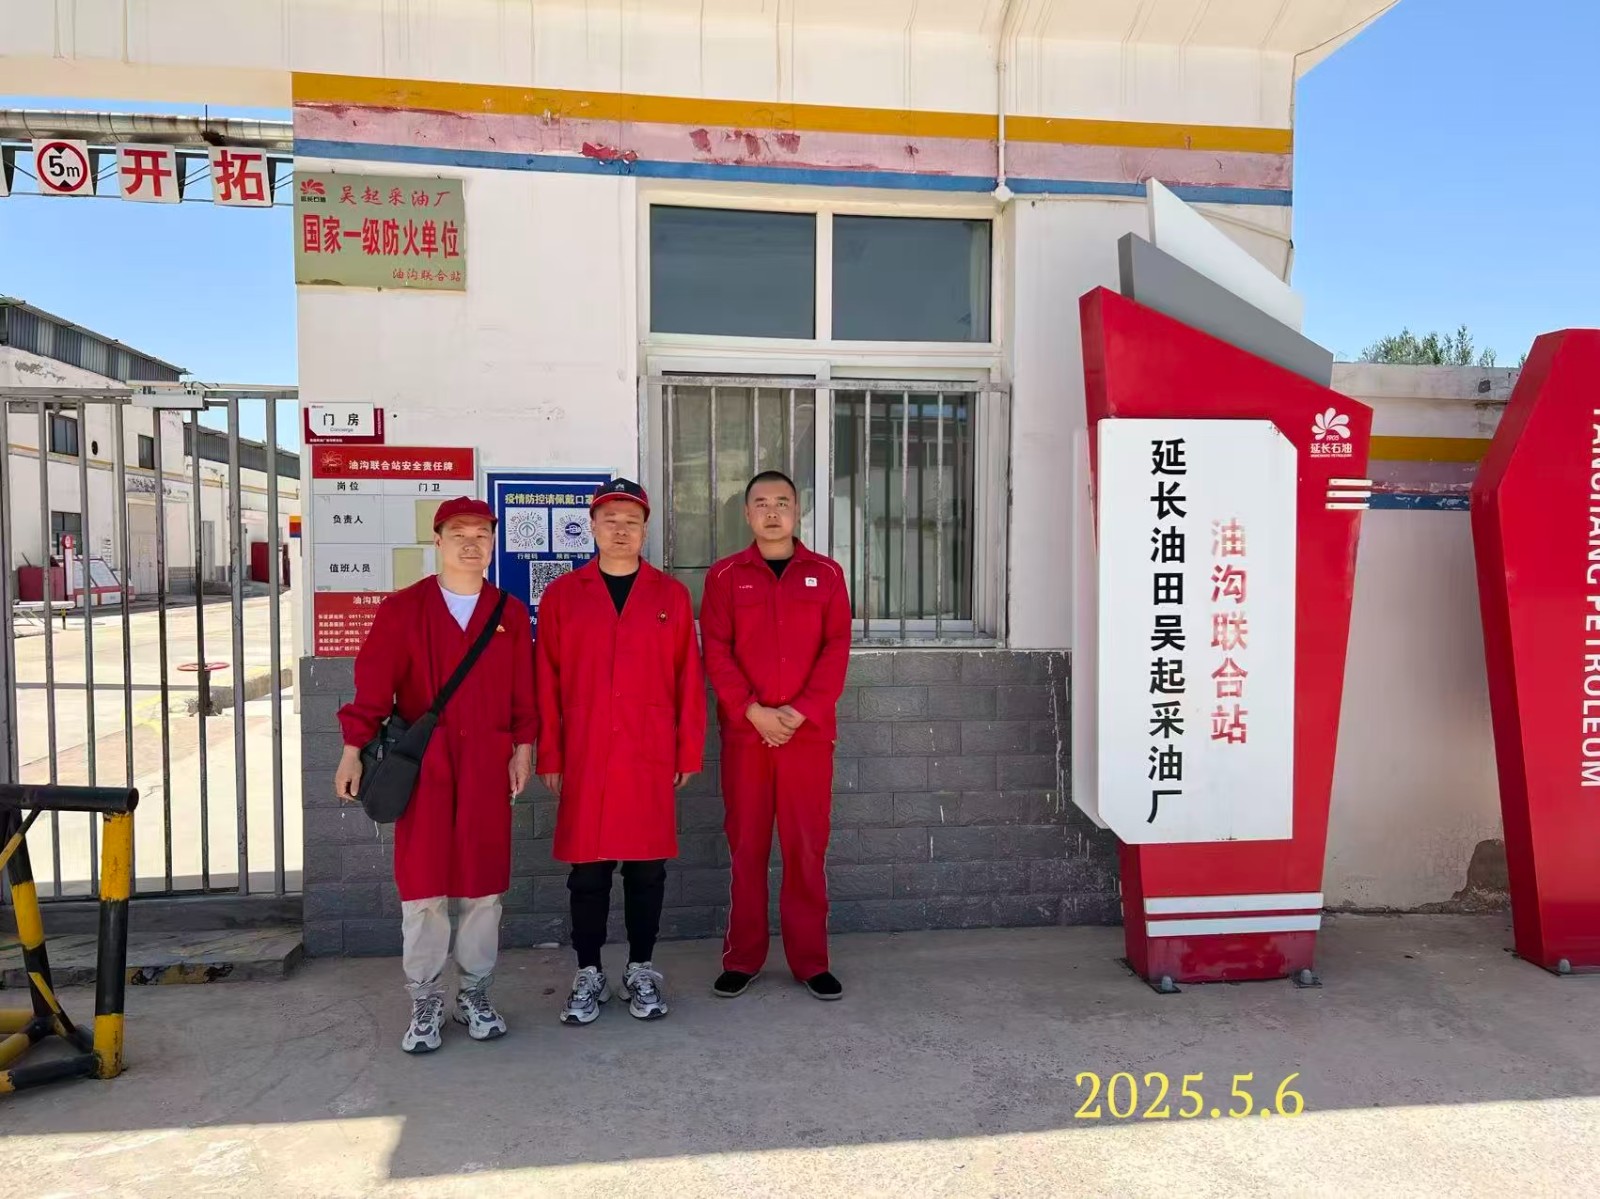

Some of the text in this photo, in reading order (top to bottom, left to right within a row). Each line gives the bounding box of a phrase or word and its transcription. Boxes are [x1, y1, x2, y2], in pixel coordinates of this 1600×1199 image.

[49, 155, 80, 178] 5m
[121, 148, 265, 201] 开 拓
[338, 185, 451, 207] 吴起采油厂
[303, 213, 459, 258] 国家一级防火单位
[392, 268, 462, 282] 油沟联合站
[323, 413, 359, 426] 门房
[1310, 442, 1353, 454] 延长石油
[349, 460, 453, 471] 油沟联合站安全责任牌
[337, 481, 441, 492] 岗位 门卫
[333, 514, 363, 524] 负责人
[329, 563, 371, 573] 值班人员
[1147, 437, 1188, 824] 延长油田吴起采油厂
[1210, 517, 1249, 744] 油沟联合站
